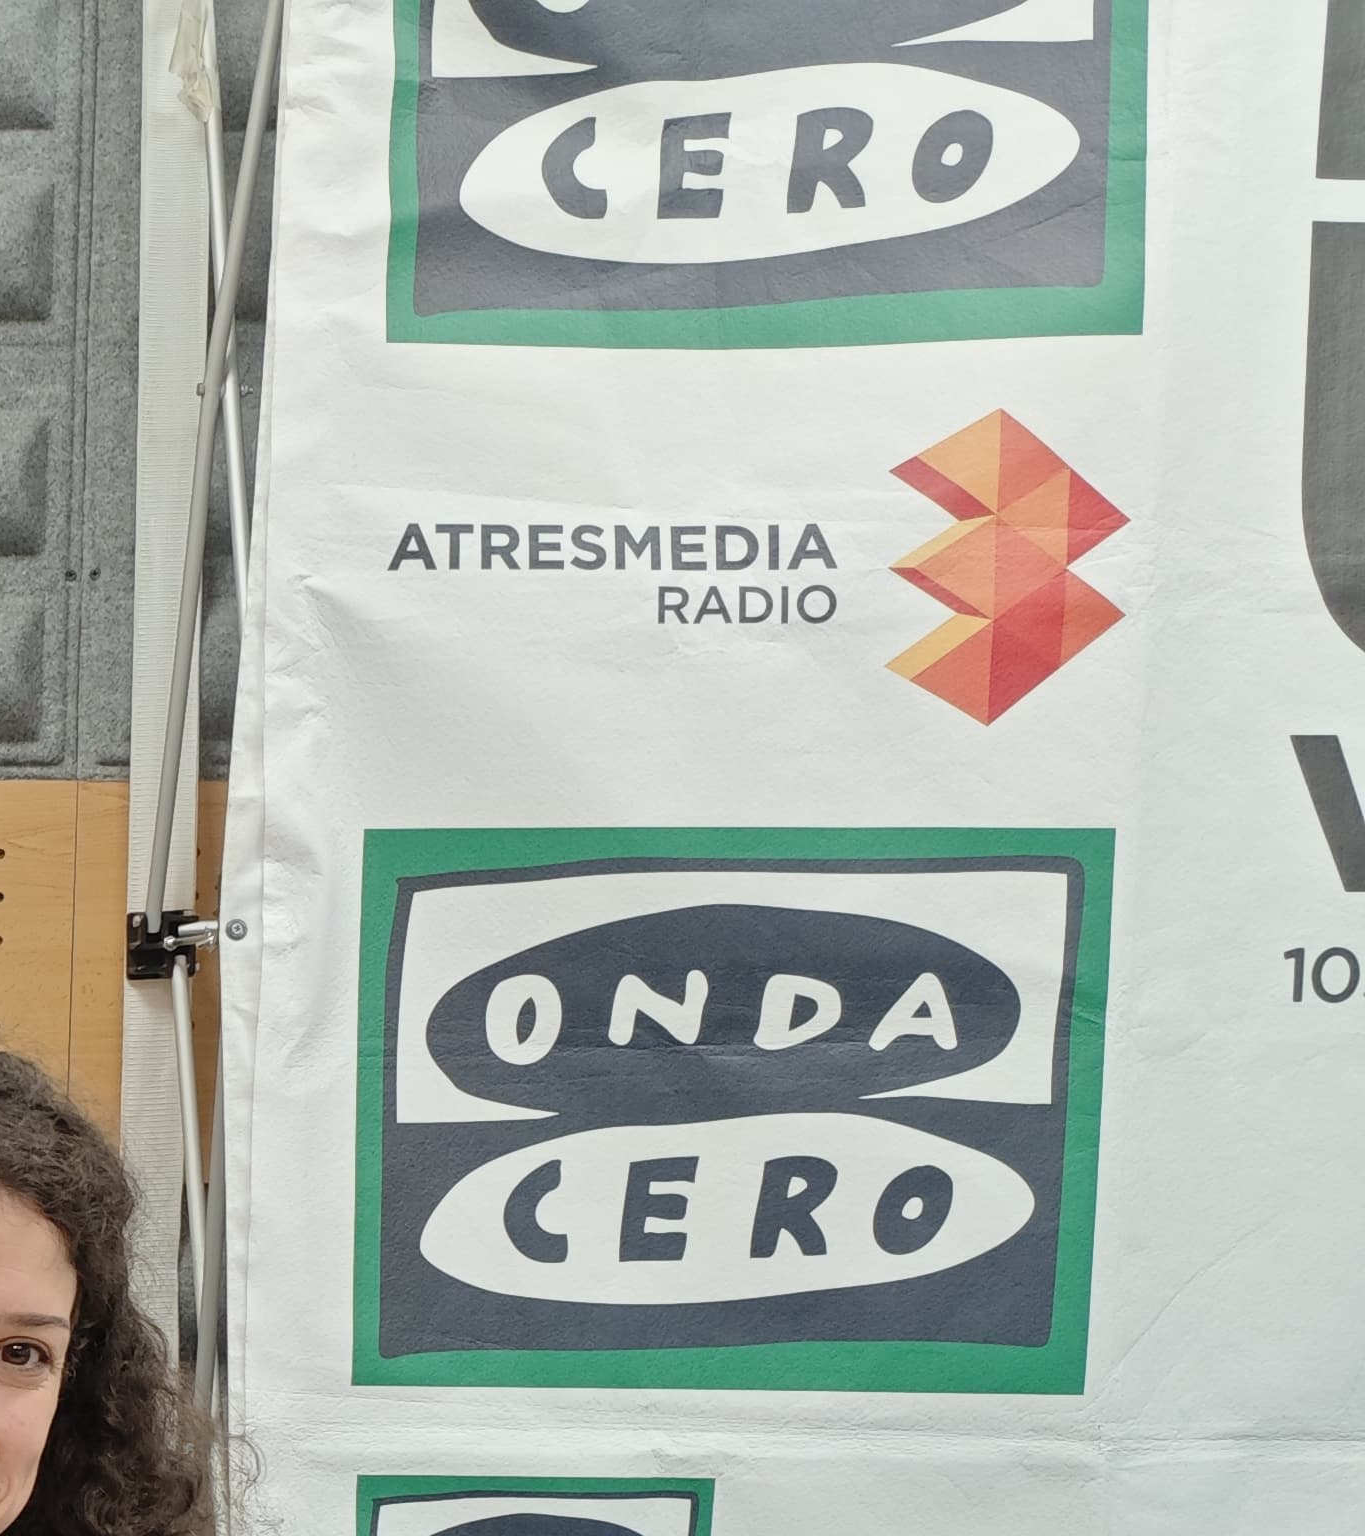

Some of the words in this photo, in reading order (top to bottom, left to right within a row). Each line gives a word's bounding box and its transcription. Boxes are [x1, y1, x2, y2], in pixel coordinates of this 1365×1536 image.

[541, 106, 996, 222] CERO
[387, 521, 838, 573] ATRESMEDIA
[657, 583, 838, 626] RADIO
[1283, 945, 1365, 1004] 10
[484, 968, 960, 1066] ONDA
[503, 1154, 955, 1264] CERO
